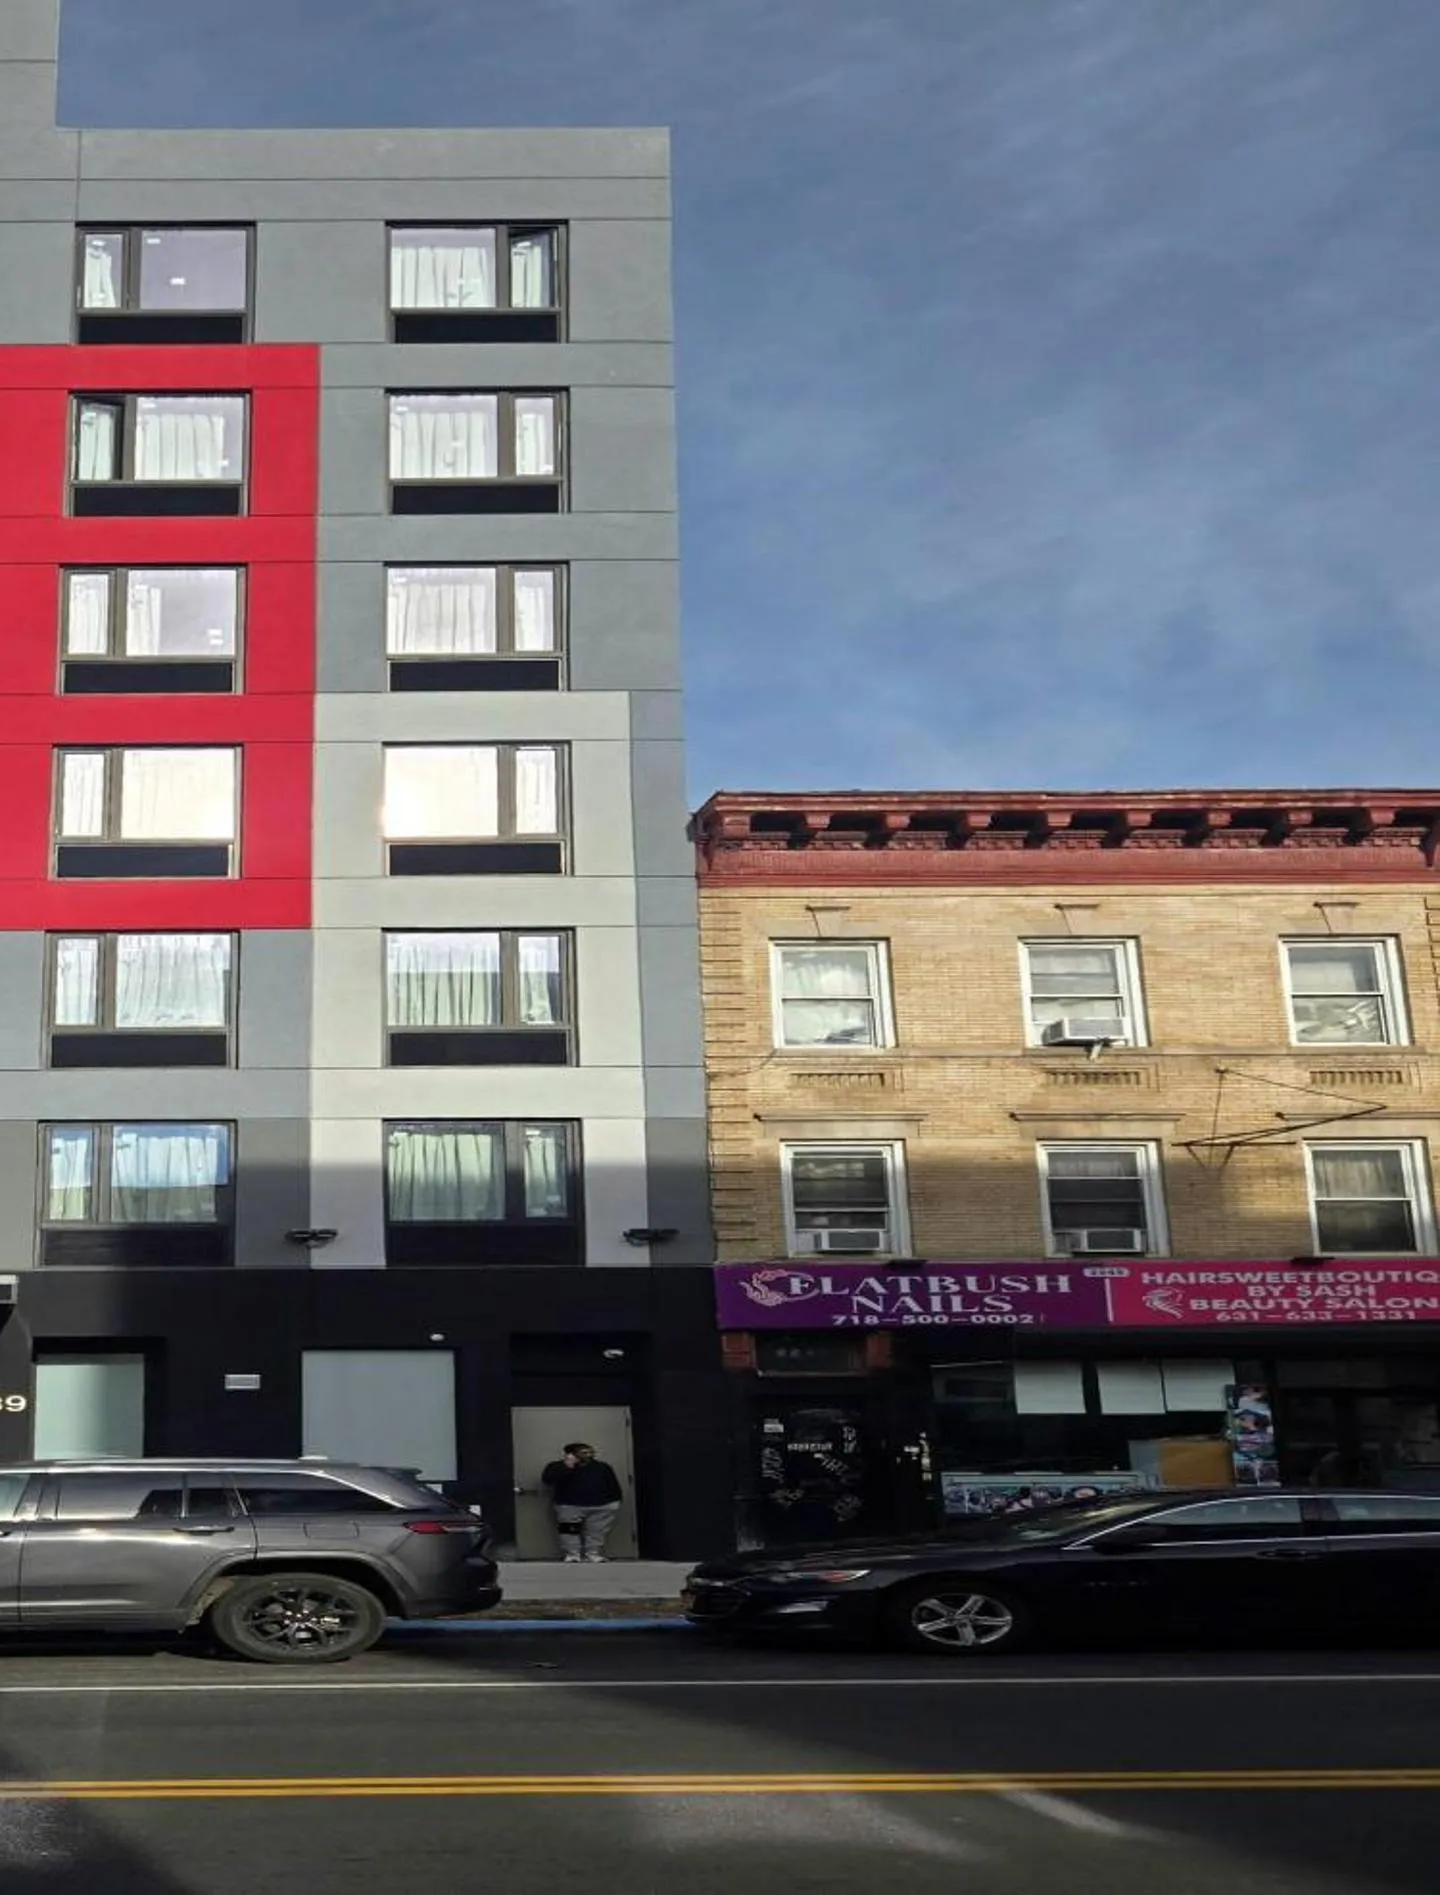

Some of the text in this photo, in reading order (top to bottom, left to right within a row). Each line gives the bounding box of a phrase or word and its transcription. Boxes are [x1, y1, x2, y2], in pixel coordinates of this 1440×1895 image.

[790, 1274, 1072, 1295] FLATBUSH
[1247, 1284, 1285, 1297] BY
[850, 1294, 1013, 1314] NAILS
[1190, 1297, 1439, 1310] BEAUTY SALON
